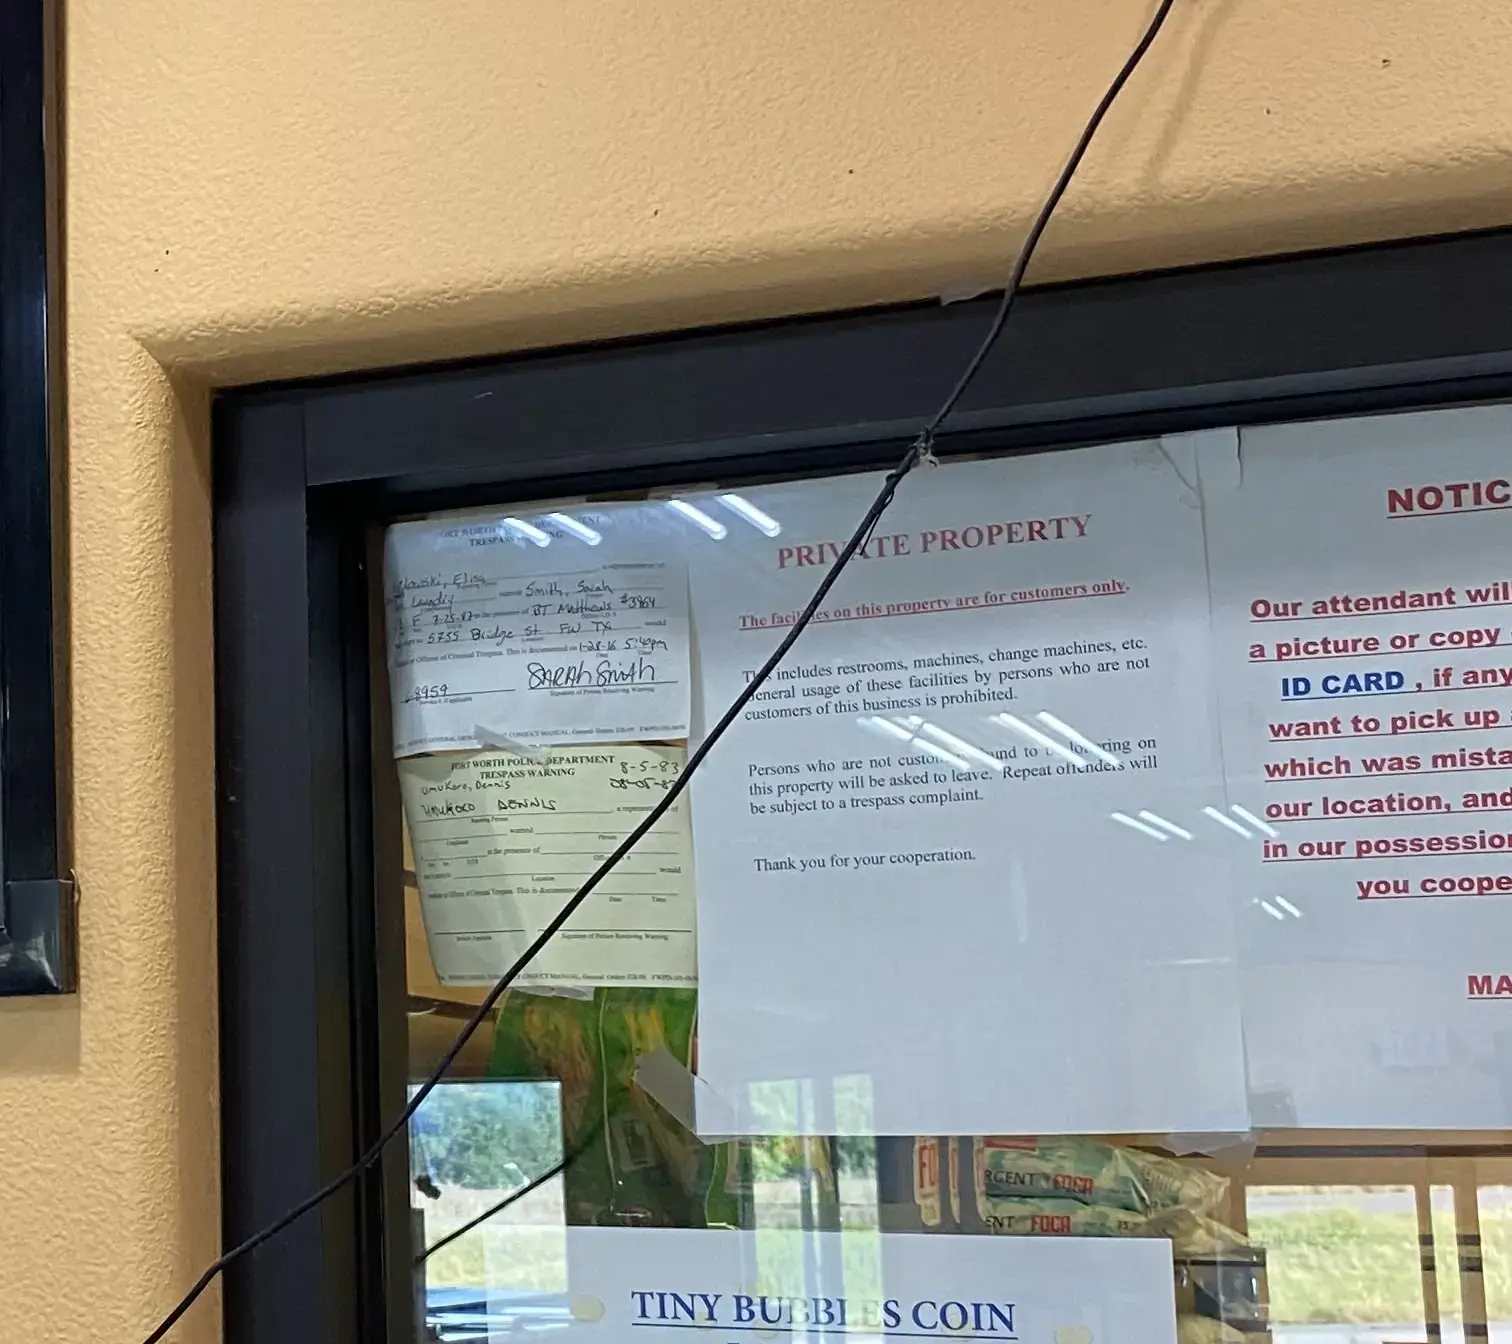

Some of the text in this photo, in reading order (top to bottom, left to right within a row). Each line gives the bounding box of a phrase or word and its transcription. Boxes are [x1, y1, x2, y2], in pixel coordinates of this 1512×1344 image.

[777, 514, 1093, 570] PRIVATE PROPERTY
[739, 615, 767, 628] The
[834, 607, 850, 618] on
[856, 603, 882, 617] this
[888, 597, 950, 616] property
[956, 594, 979, 607] are
[984, 591, 1007, 604] for
[1010, 583, 1088, 602] customers
[1250, 586, 1456, 618] Our attendant
[777, 665, 832, 681] includes
[837, 658, 909, 676] restrooms,
[913, 652, 984, 669] machines,
[988, 648, 1038, 663] change
[1043, 641, 1117, 658] machines,
[1122, 638, 1148, 650] etc.
[1249, 627, 1501, 661] a picture or copy
[802, 657, 1150, 699] usage of these facilities by persons who are not
[1282, 676, 1311, 697] ID
[1322, 671, 1405, 694] CARD
[1433, 667, 1453, 687] if
[745, 687, 1018, 721] customers of this business is prohibited.
[1269, 709, 1500, 738] want to pick up
[472, 758, 505, 768] WORTH
[546, 755, 615, 766] DEPARTMENT
[480, 767, 576, 779] TRESPASS WARNING
[748, 763, 800, 777] Persons
[806, 759, 836, 773] who
[842, 758, 863, 770] are
[869, 755, 892, 769] not
[1024, 746, 1039, 757] to
[1137, 738, 1156, 750] on
[1264, 756, 1351, 778] which
[1361, 755, 1421, 773] was
[749, 783, 773, 796] this
[777, 780, 834, 797] property
[838, 775, 864, 790] will
[869, 775, 886, 788] be
[890, 771, 929, 786] asked
[934, 772, 947, 784] to
[952, 769, 993, 783] leave.
[1002, 765, 1052, 781] Repeat
[1130, 754, 1158, 769] will
[750, 788, 984, 816] be subject to a trespass complaint.
[1265, 801, 1312, 819] our
[1322, 793, 1451, 816] location,
[754, 847, 976, 873] Thank you for your cooperation.
[1263, 839, 1347, 858] in our
[1356, 878, 1410, 900] you
[631, 1291, 723, 1323] TINY
[911, 1300, 1017, 1334] COIN
